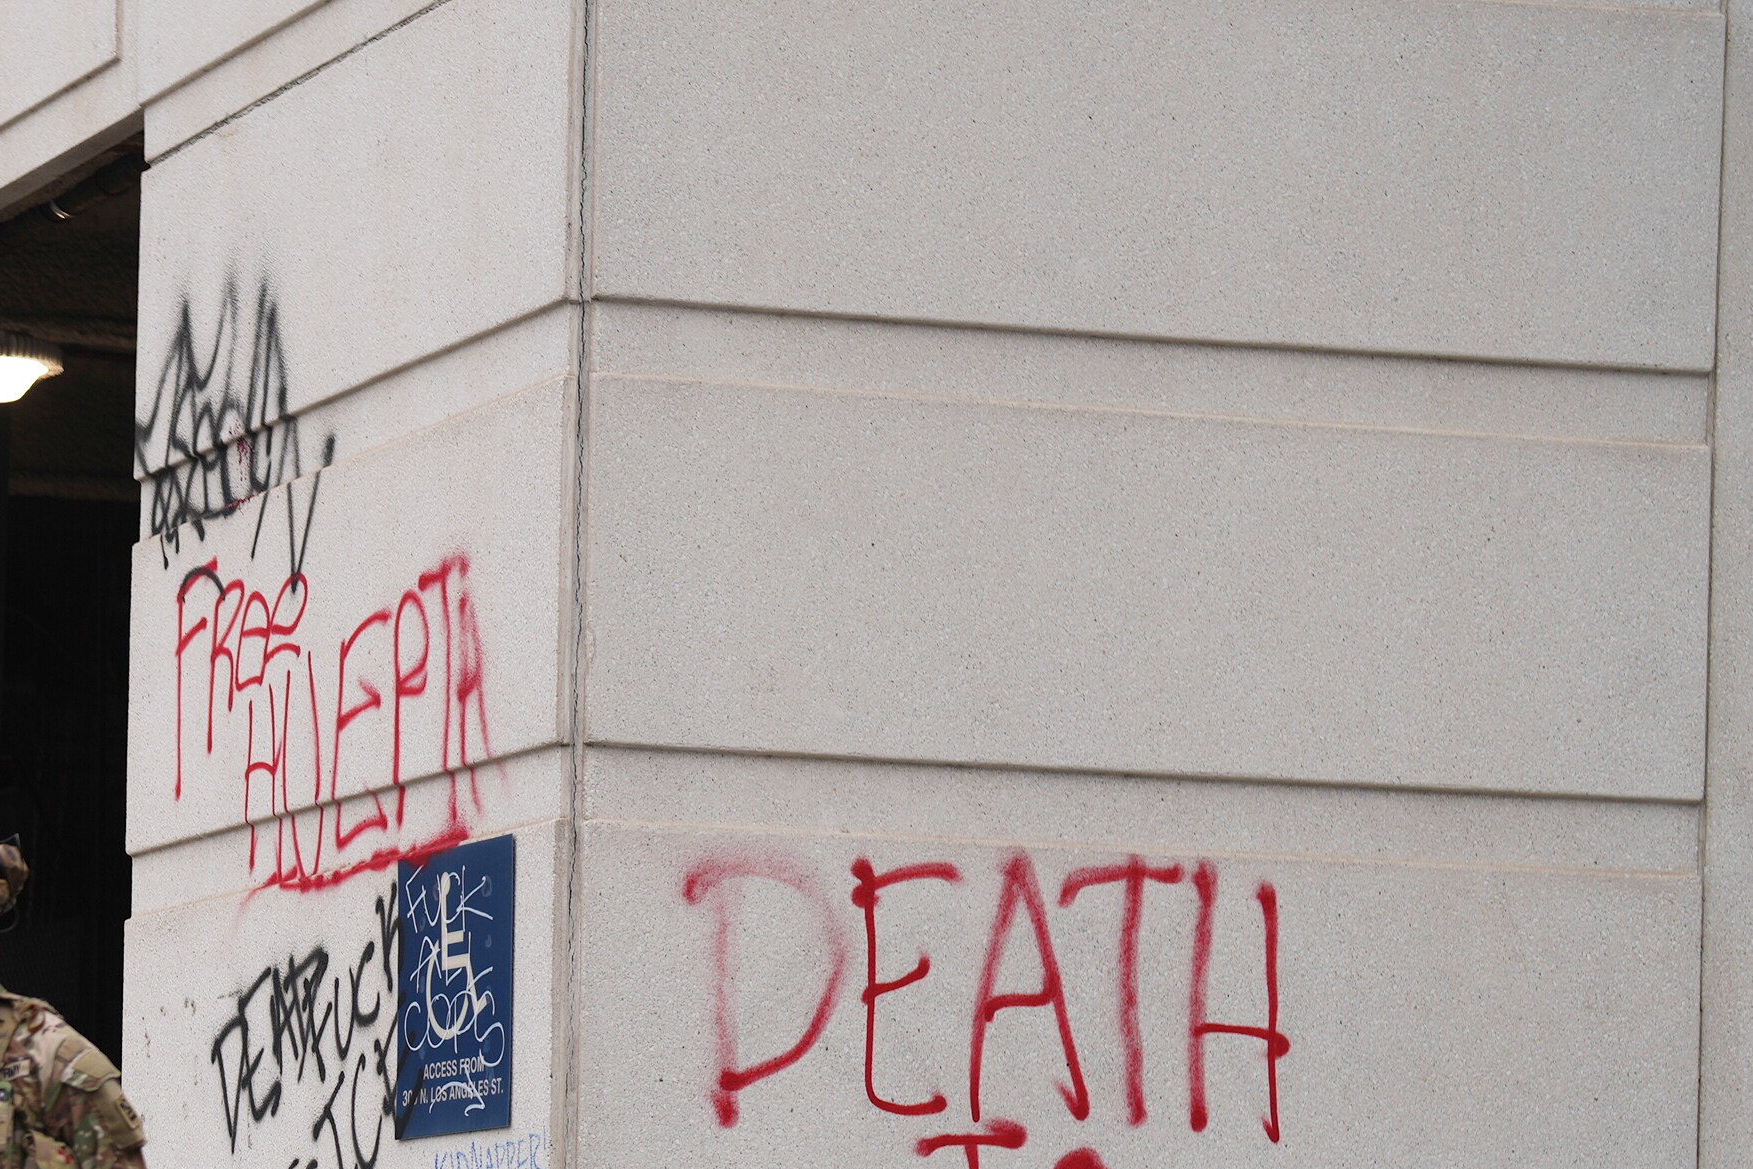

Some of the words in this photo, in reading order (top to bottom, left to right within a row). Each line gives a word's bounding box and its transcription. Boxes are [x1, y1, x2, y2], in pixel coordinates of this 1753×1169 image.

[175, 556, 308, 801] FREE
[406, 865, 493, 933] FUCK
[404, 990, 505, 1067] COPS
[680, 852, 1293, 1144] DEATH
[402, 1090, 419, 1107] 30
[431, 1085, 447, 1103] LOS
[449, 1079, 489, 1101] ANGELES
[491, 1077, 504, 1095] ST.
[423, 1059, 457, 1080] ACCESS
[459, 1056, 485, 1075] FROM
